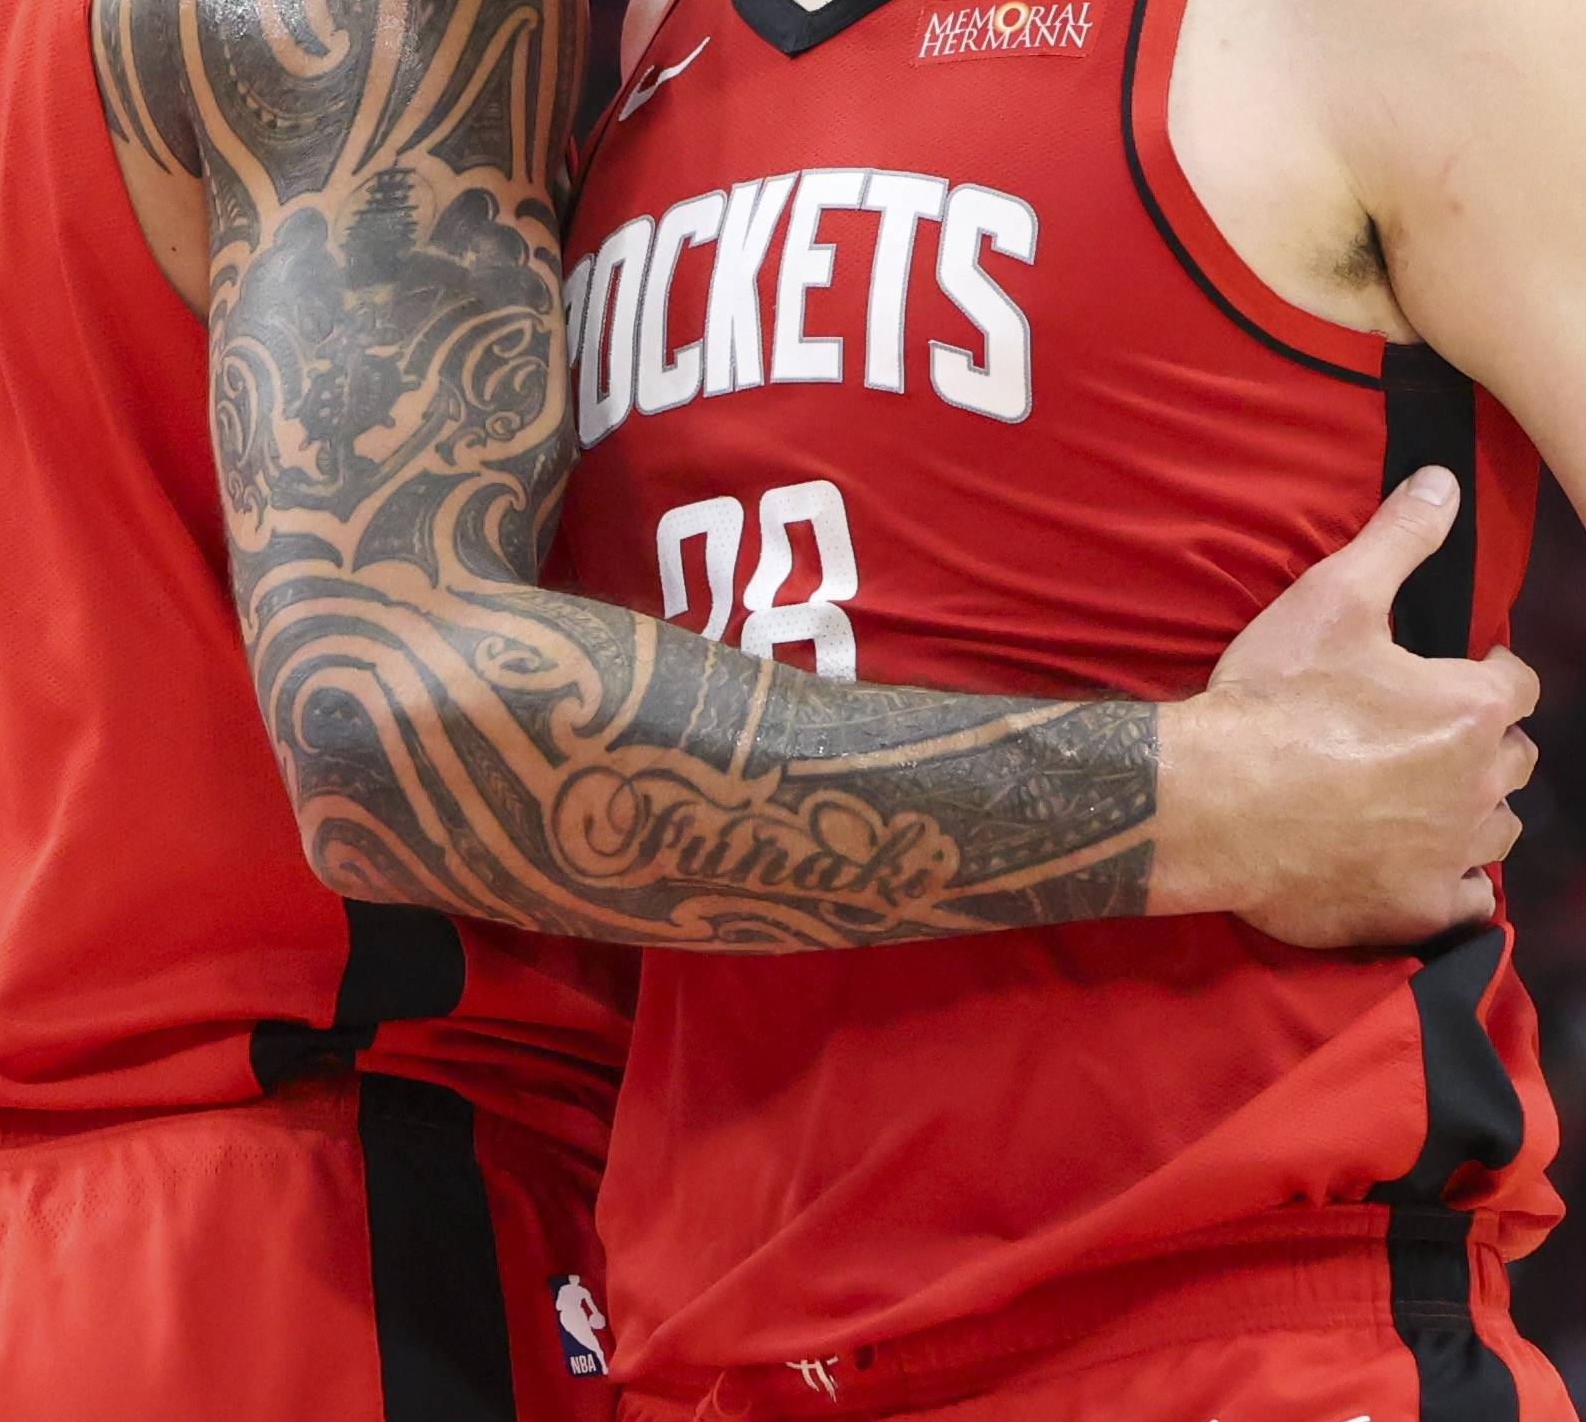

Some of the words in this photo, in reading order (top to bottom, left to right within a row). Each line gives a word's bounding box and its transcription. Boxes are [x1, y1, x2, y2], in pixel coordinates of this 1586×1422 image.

[926, 0, 1094, 36] MEMORIAL
[918, 23, 1094, 59] HERMANN
[569, 1354, 597, 1375] NBA
